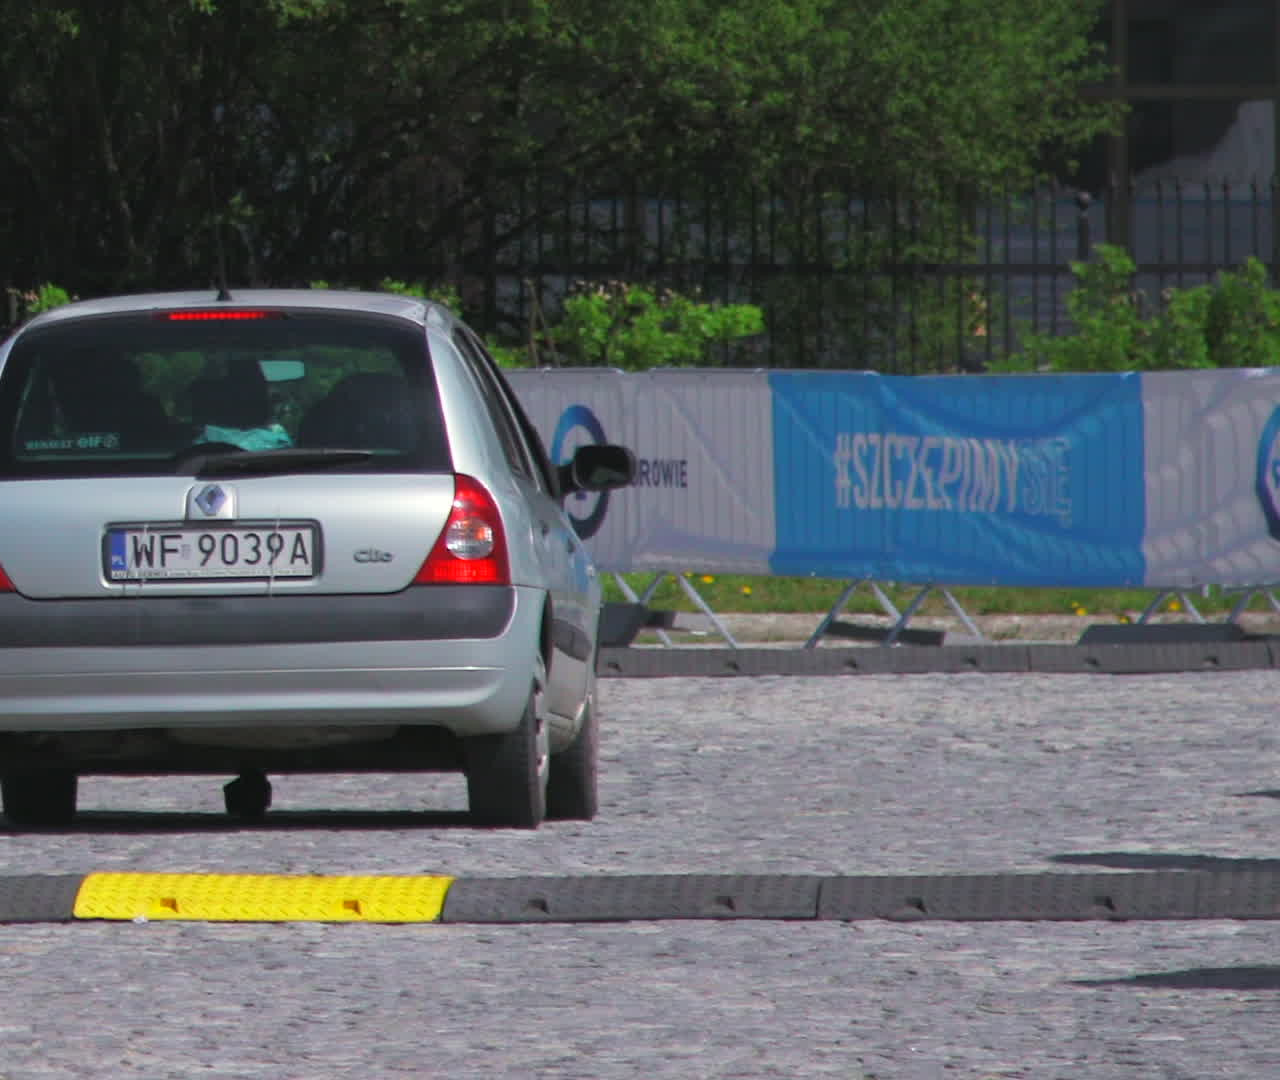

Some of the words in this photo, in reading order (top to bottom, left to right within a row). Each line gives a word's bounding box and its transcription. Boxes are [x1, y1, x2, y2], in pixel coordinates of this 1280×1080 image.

[632, 459, 688, 488] ROWIE
[132, 534, 183, 568] WF
[197, 532, 310, 568] 9039A
